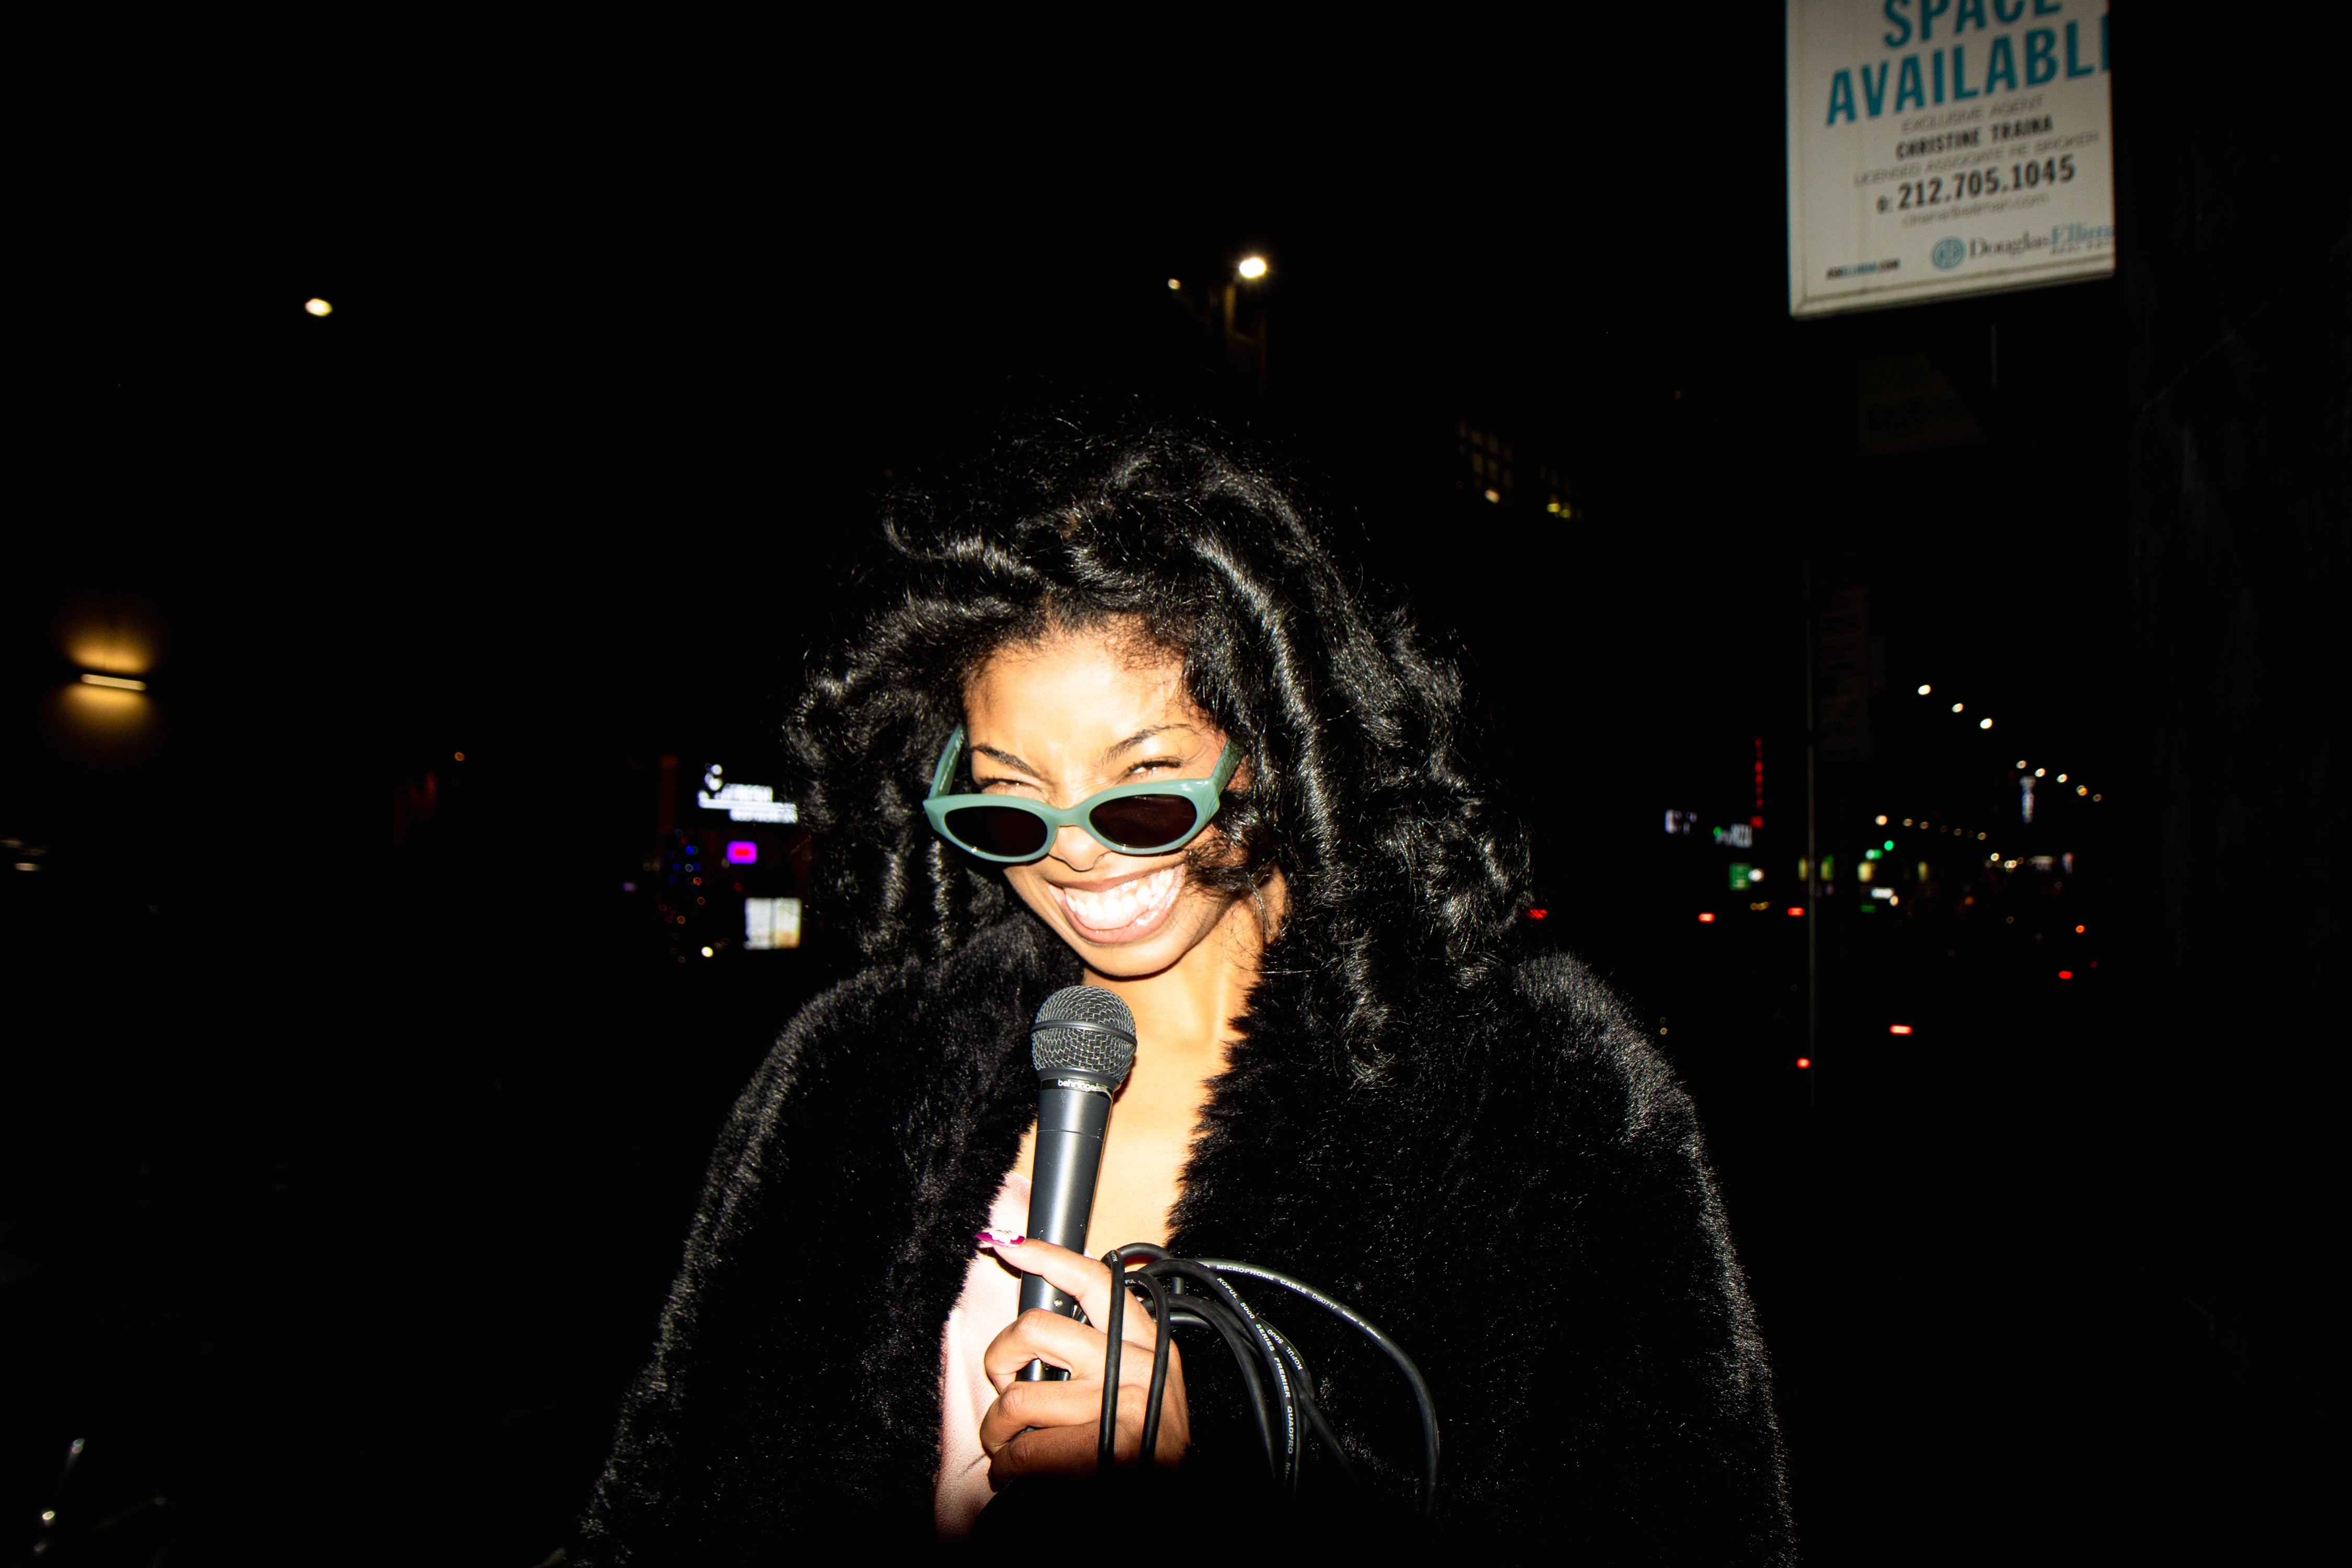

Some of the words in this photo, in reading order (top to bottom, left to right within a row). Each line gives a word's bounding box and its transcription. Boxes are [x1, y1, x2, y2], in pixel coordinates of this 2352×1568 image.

[1884, 0, 2062, 47] SPA
[1896, 128, 1981, 160] CHRISTINE
[1990, 114, 2054, 143] TRAINA
[1897, 155, 2076, 211] 212.705.1045
[1216, 1264, 1274, 1280] MICROPHONE
[1279, 1278, 1307, 1294] CABLE
[1311, 1293, 1338, 1309] DS0717
[1341, 1310, 1358, 1322] Made
[1366, 1326, 1381, 1340] China
[1217, 1277, 1238, 1299] KOPUL
[1240, 1301, 1255, 1320] 5000
[1255, 1323, 1275, 1352] SERIES
[1274, 1357, 1291, 1399] PREMIER
[1286, 1346, 1303, 1370] KOPUL
